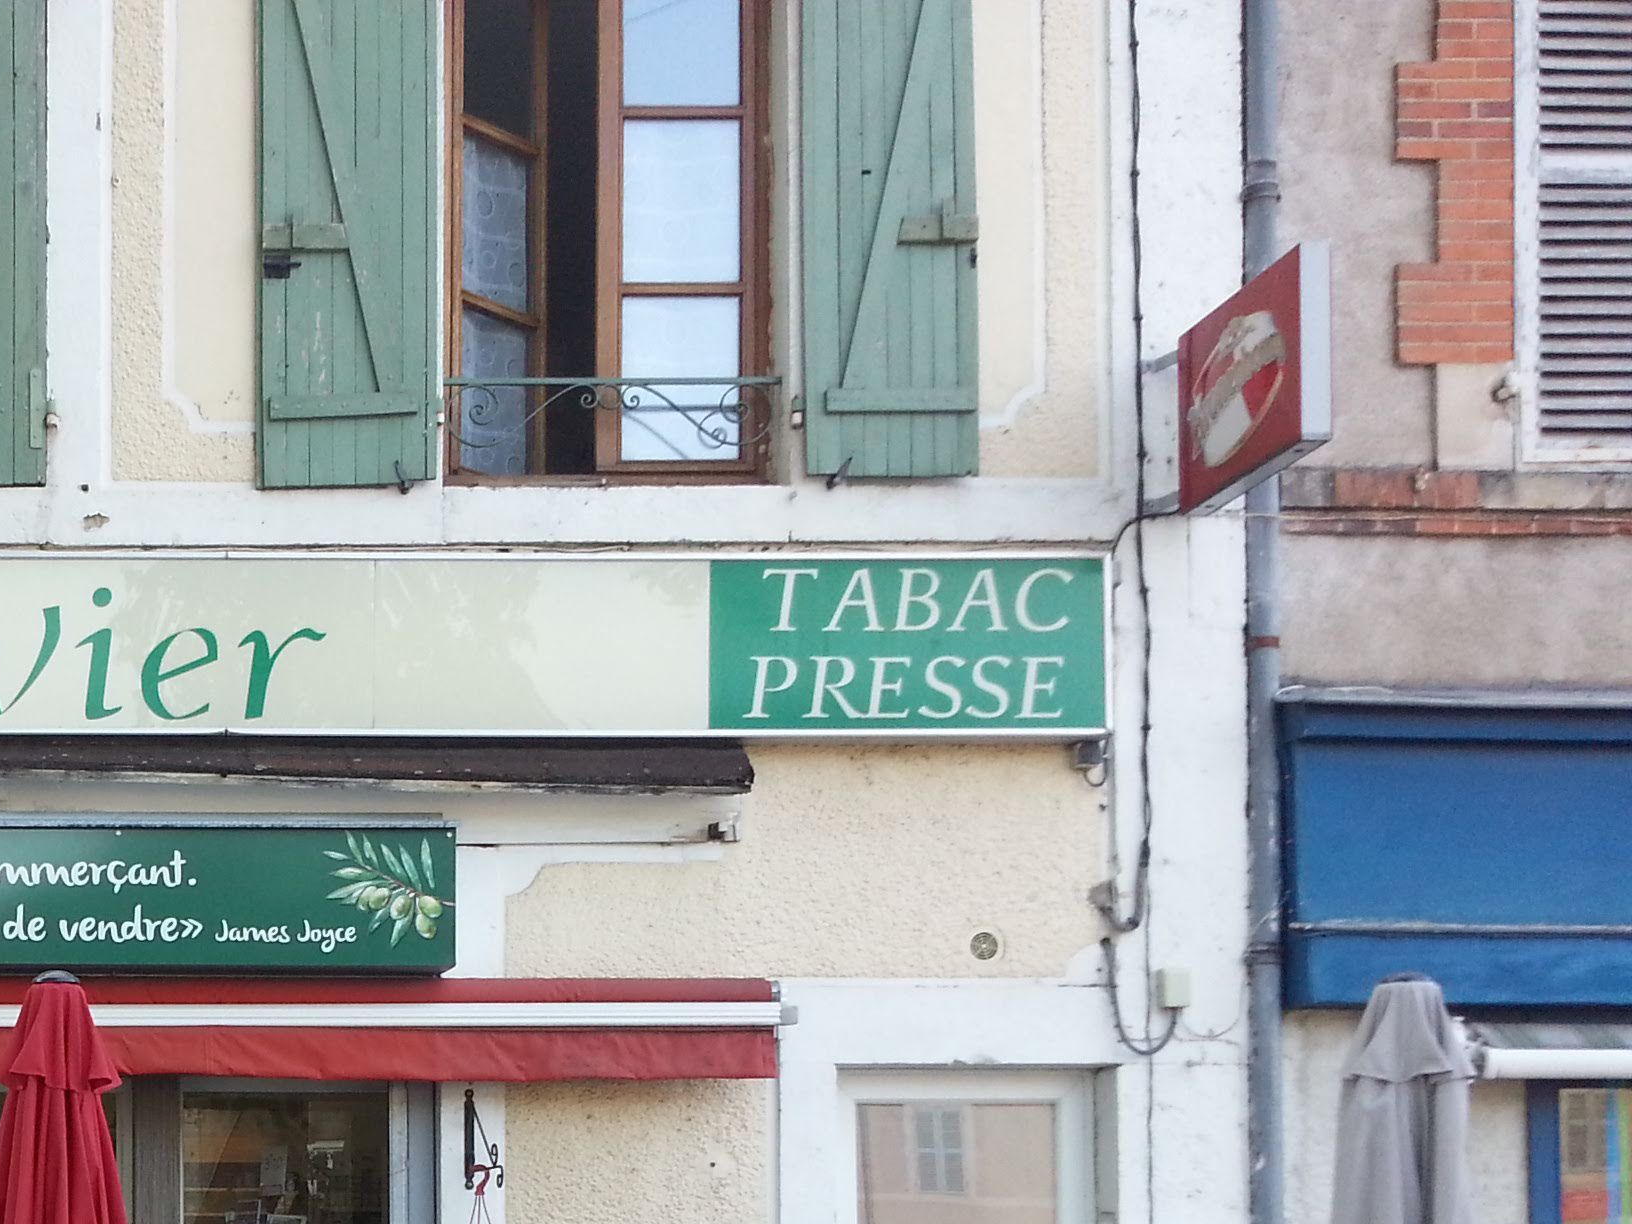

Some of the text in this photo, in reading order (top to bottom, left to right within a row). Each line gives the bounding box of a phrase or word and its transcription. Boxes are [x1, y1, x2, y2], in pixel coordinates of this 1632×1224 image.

[762, 567, 1074, 633] TABAC
[742, 654, 1066, 720] PRESSE
[3, 904, 47, 941] de
[215, 919, 291, 943] James
[297, 919, 358, 953] Joyce
